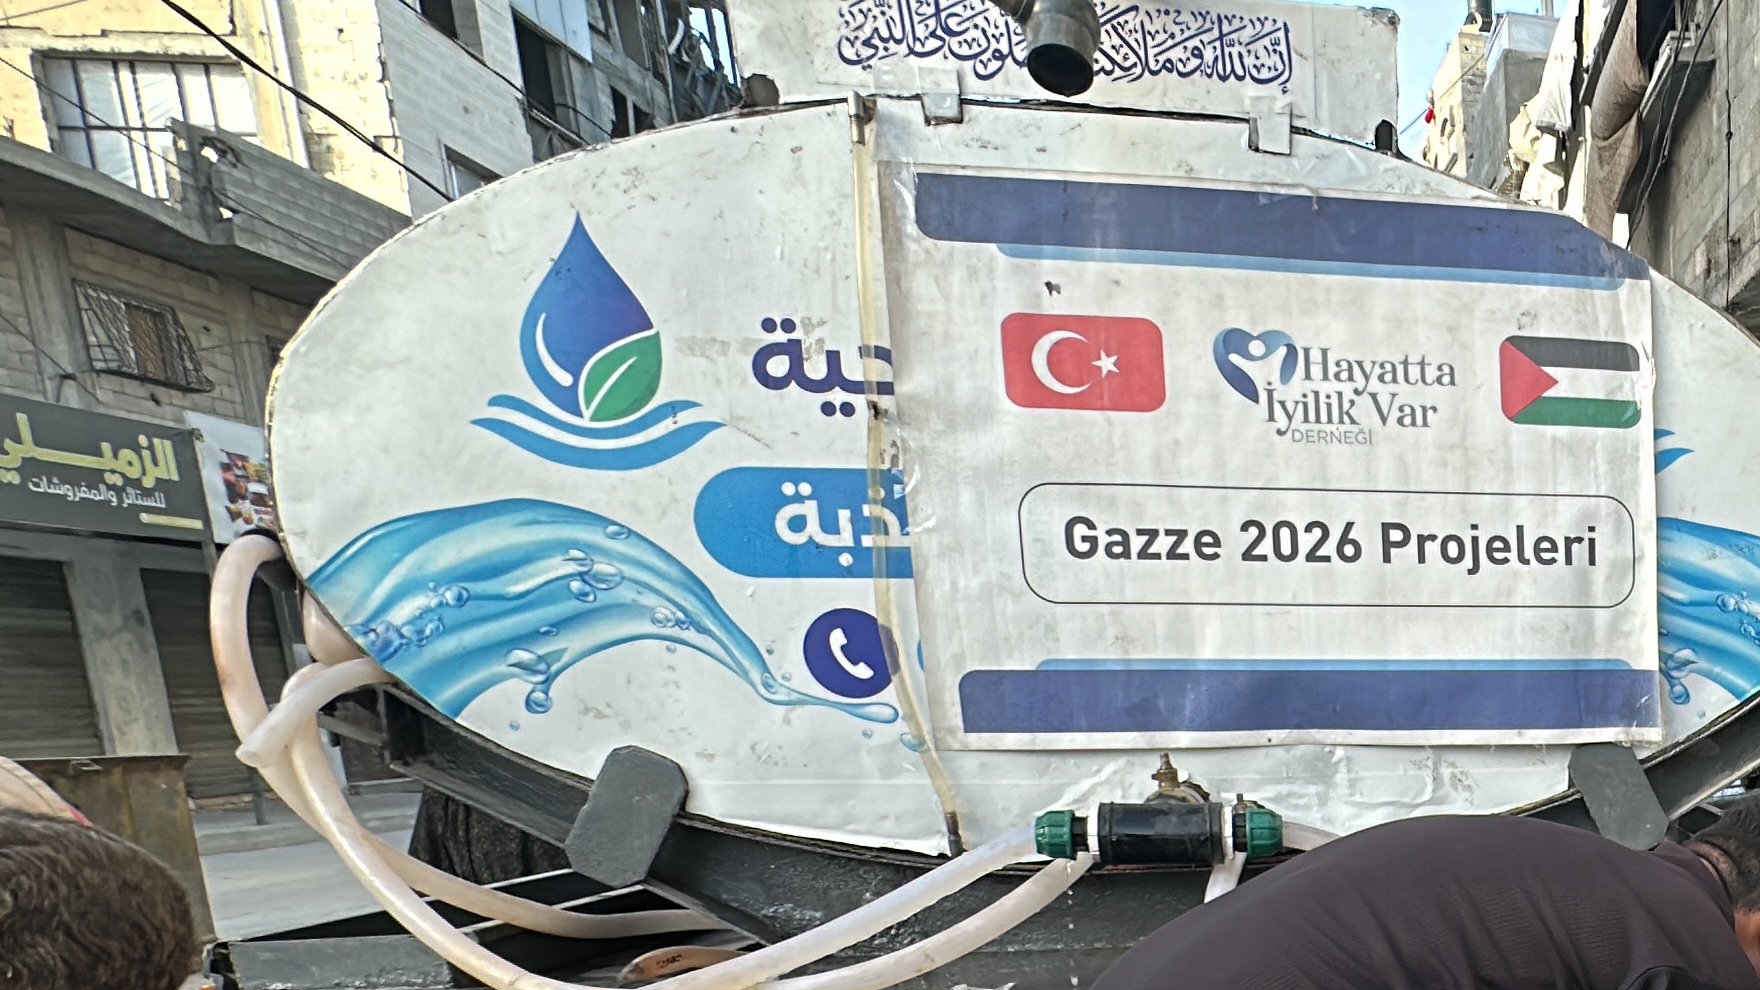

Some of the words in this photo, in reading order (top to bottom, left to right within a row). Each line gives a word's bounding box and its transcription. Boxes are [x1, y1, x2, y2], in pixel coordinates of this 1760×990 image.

[752, 317, 895, 417] حية
[1300, 346, 1458, 396] Hayatta
[1263, 381, 1361, 436] İyilik
[1367, 392, 1438, 428] Var
[1291, 427, 1373, 446] DERNEĞİ
[28, 474, 118, 507] والمفروشات
[774, 481, 911, 567] ذبة
[1064, 515, 1222, 561] Gazze
[1240, 519, 1363, 563] 2026
[1381, 522, 1597, 575] Projeleri
